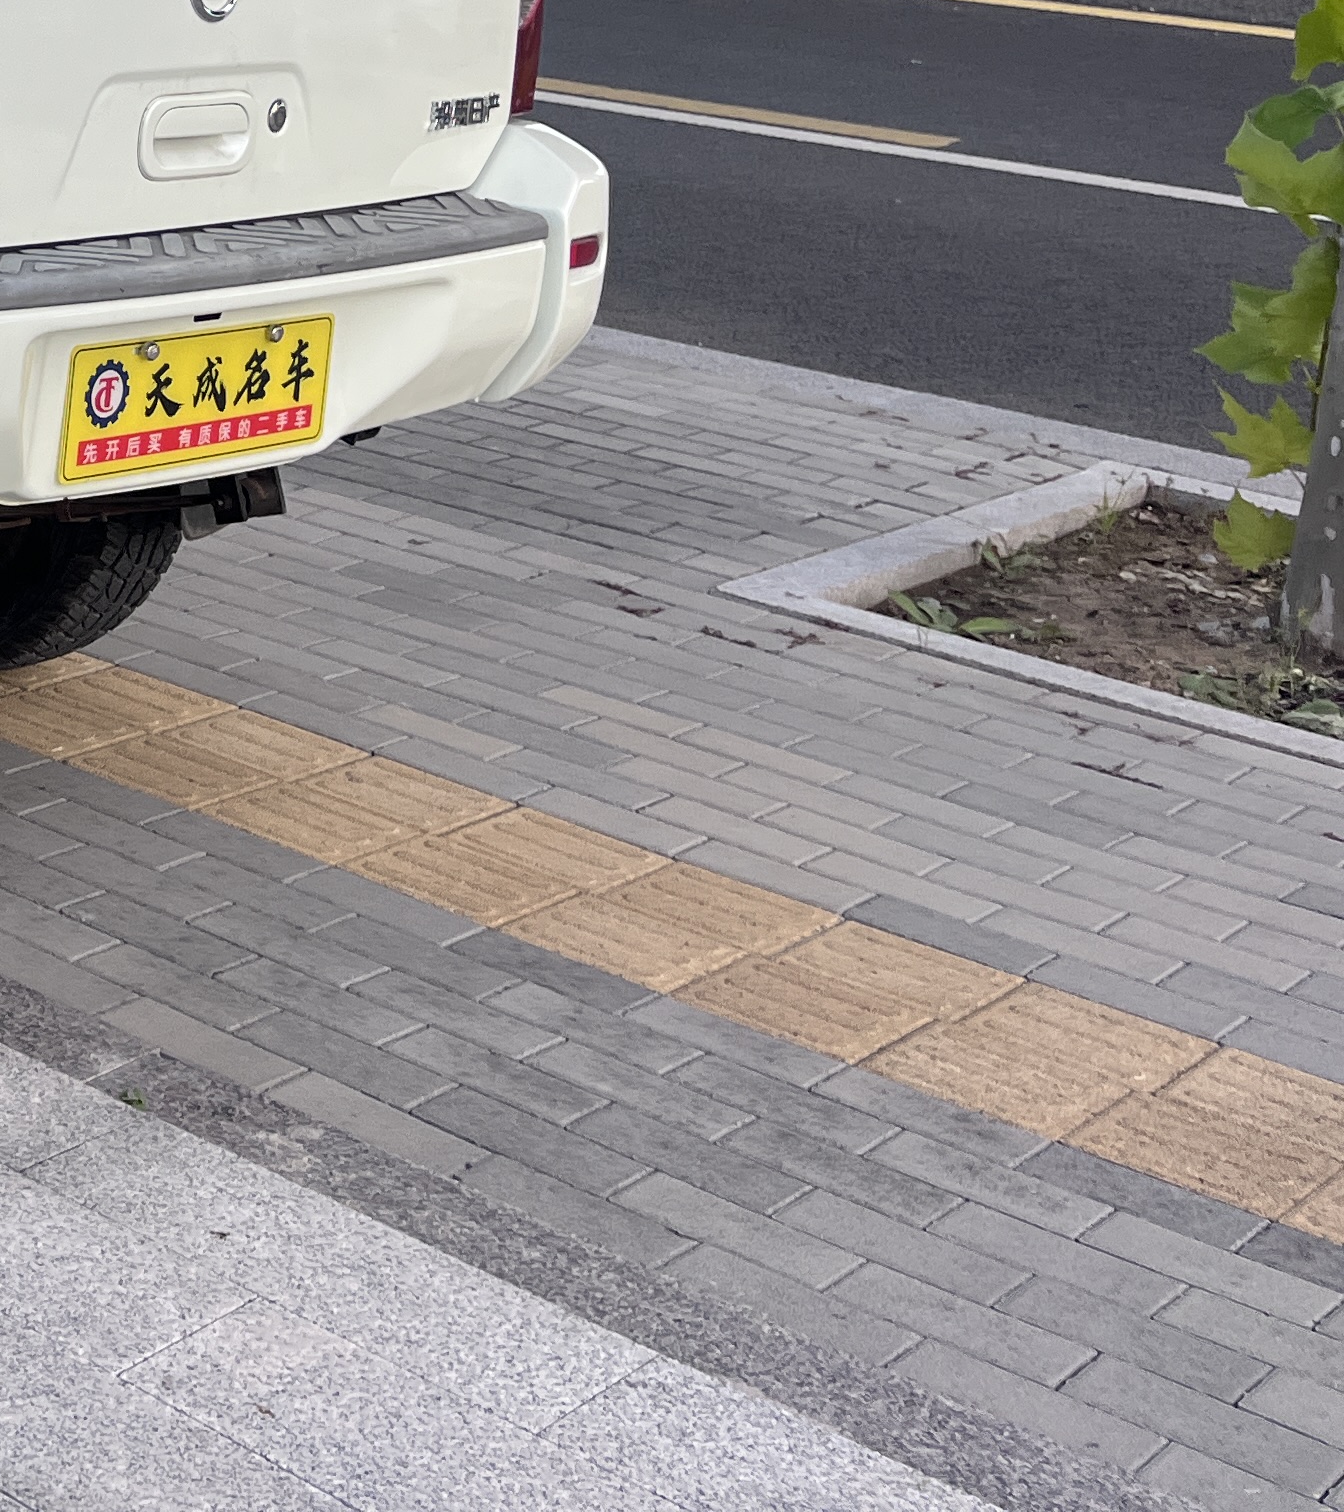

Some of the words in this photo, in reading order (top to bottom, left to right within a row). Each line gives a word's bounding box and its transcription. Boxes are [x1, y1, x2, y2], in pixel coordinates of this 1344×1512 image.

[144, 338, 315, 418] 天成名车
[82, 432, 162, 464] 先开后买
[178, 408, 308, 449] 有质保的二手车
